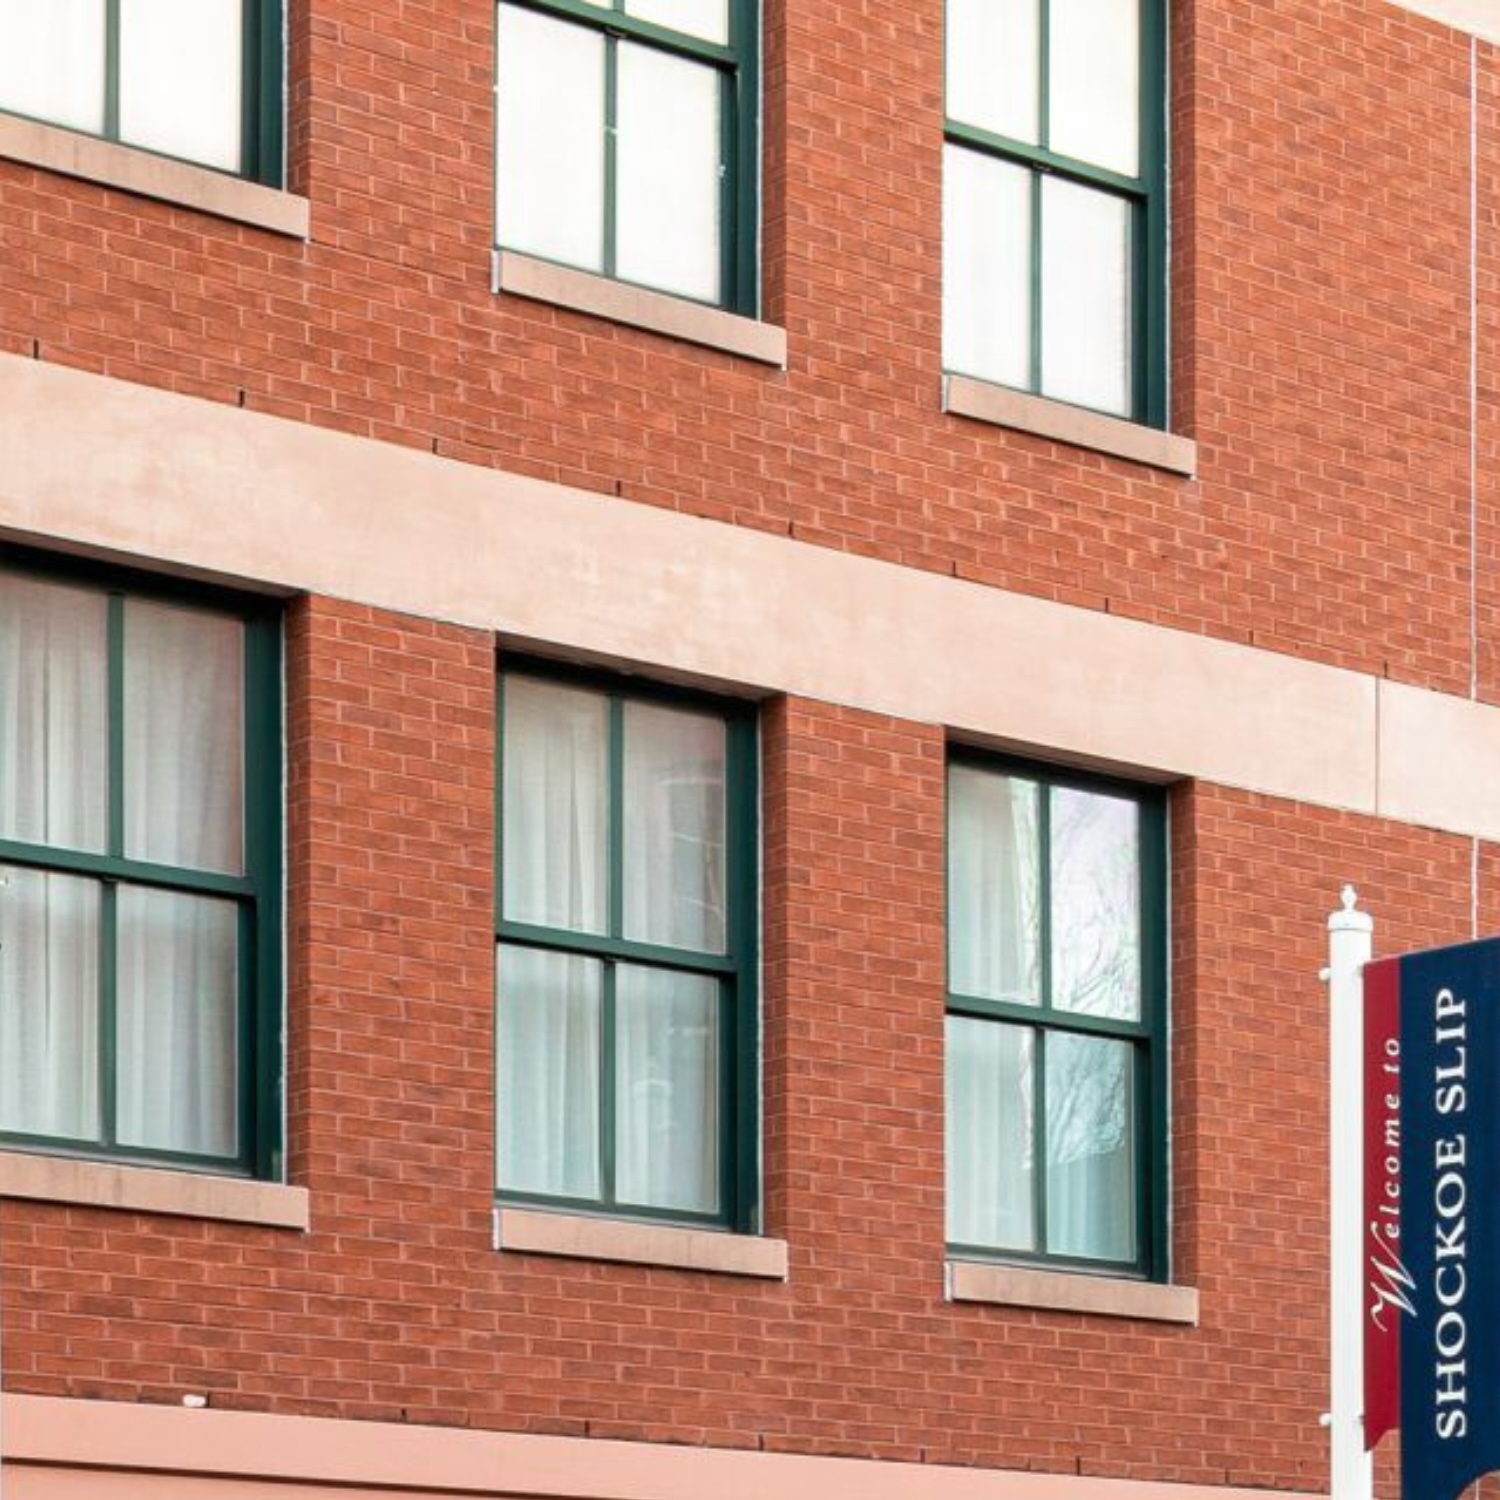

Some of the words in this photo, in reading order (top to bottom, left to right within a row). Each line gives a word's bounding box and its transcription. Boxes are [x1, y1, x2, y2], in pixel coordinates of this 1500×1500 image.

[1383, 1037, 1400, 1075] to
[1435, 987, 1466, 1115] SLIP
[1370, 1091, 1418, 1333] Welcome
[1435, 1133, 1467, 1439] SHOCKOE
